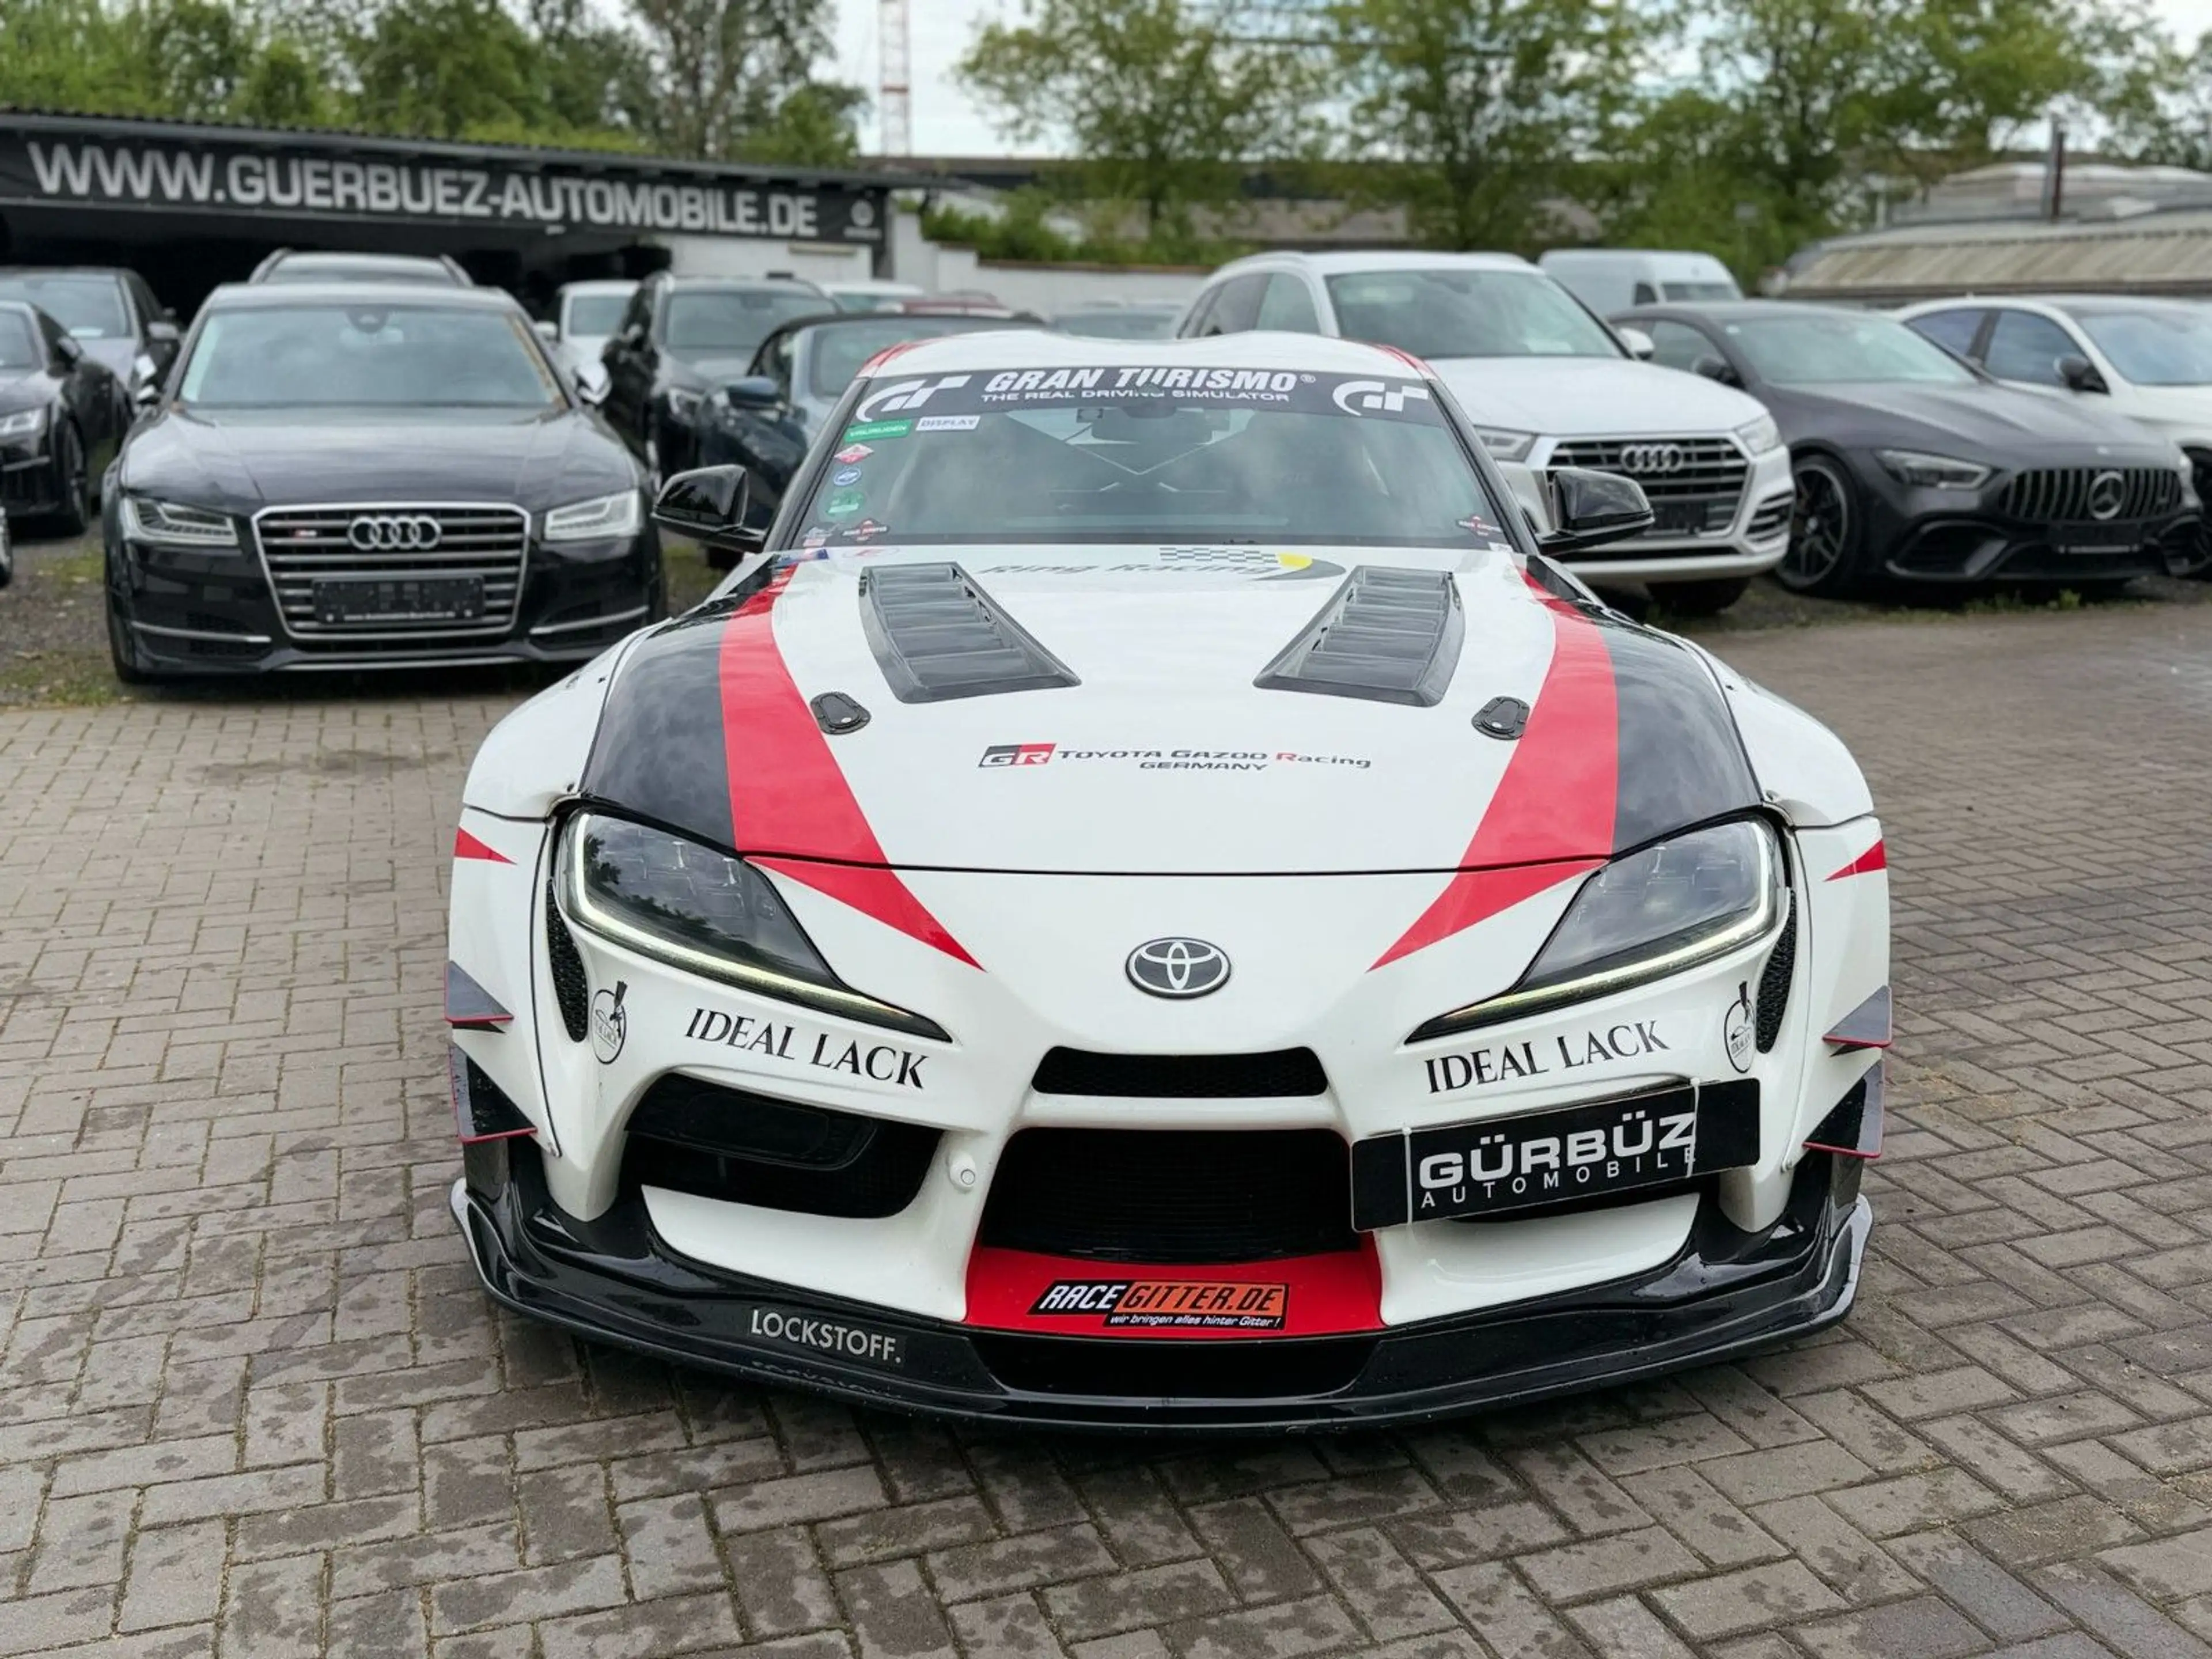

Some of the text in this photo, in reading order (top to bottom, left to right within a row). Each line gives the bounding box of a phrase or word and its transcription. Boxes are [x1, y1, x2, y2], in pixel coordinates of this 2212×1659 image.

[27, 142, 818, 236] WWW.GUERBUEZ-AUTOMOBILE.DE
[984, 369, 1104, 393] GRAN
[982, 393, 1027, 403] THE
[1029, 391, 1075, 401] REAL
[1172, 390, 1290, 402] SIMULATOR
[922, 419, 976, 427] DISPLAY
[979, 749, 1372, 769] GR TOYOTA GAZOO Racing
[1139, 762, 1268, 770] GERMANY
[685, 1007, 929, 1089] IDEAL LACK
[1425, 1042, 1550, 1094] IDEAL
[1557, 1020, 1670, 1069] LACK
[1419, 1110, 1696, 1190] GÜRBÜZ
[1129, 1314, 1173, 1325] bringen
[1202, 1315, 1238, 1325] hinter
[1239, 1316, 1274, 1327] Gitter
[751, 1309, 902, 1363] LOCKSTOFF.
